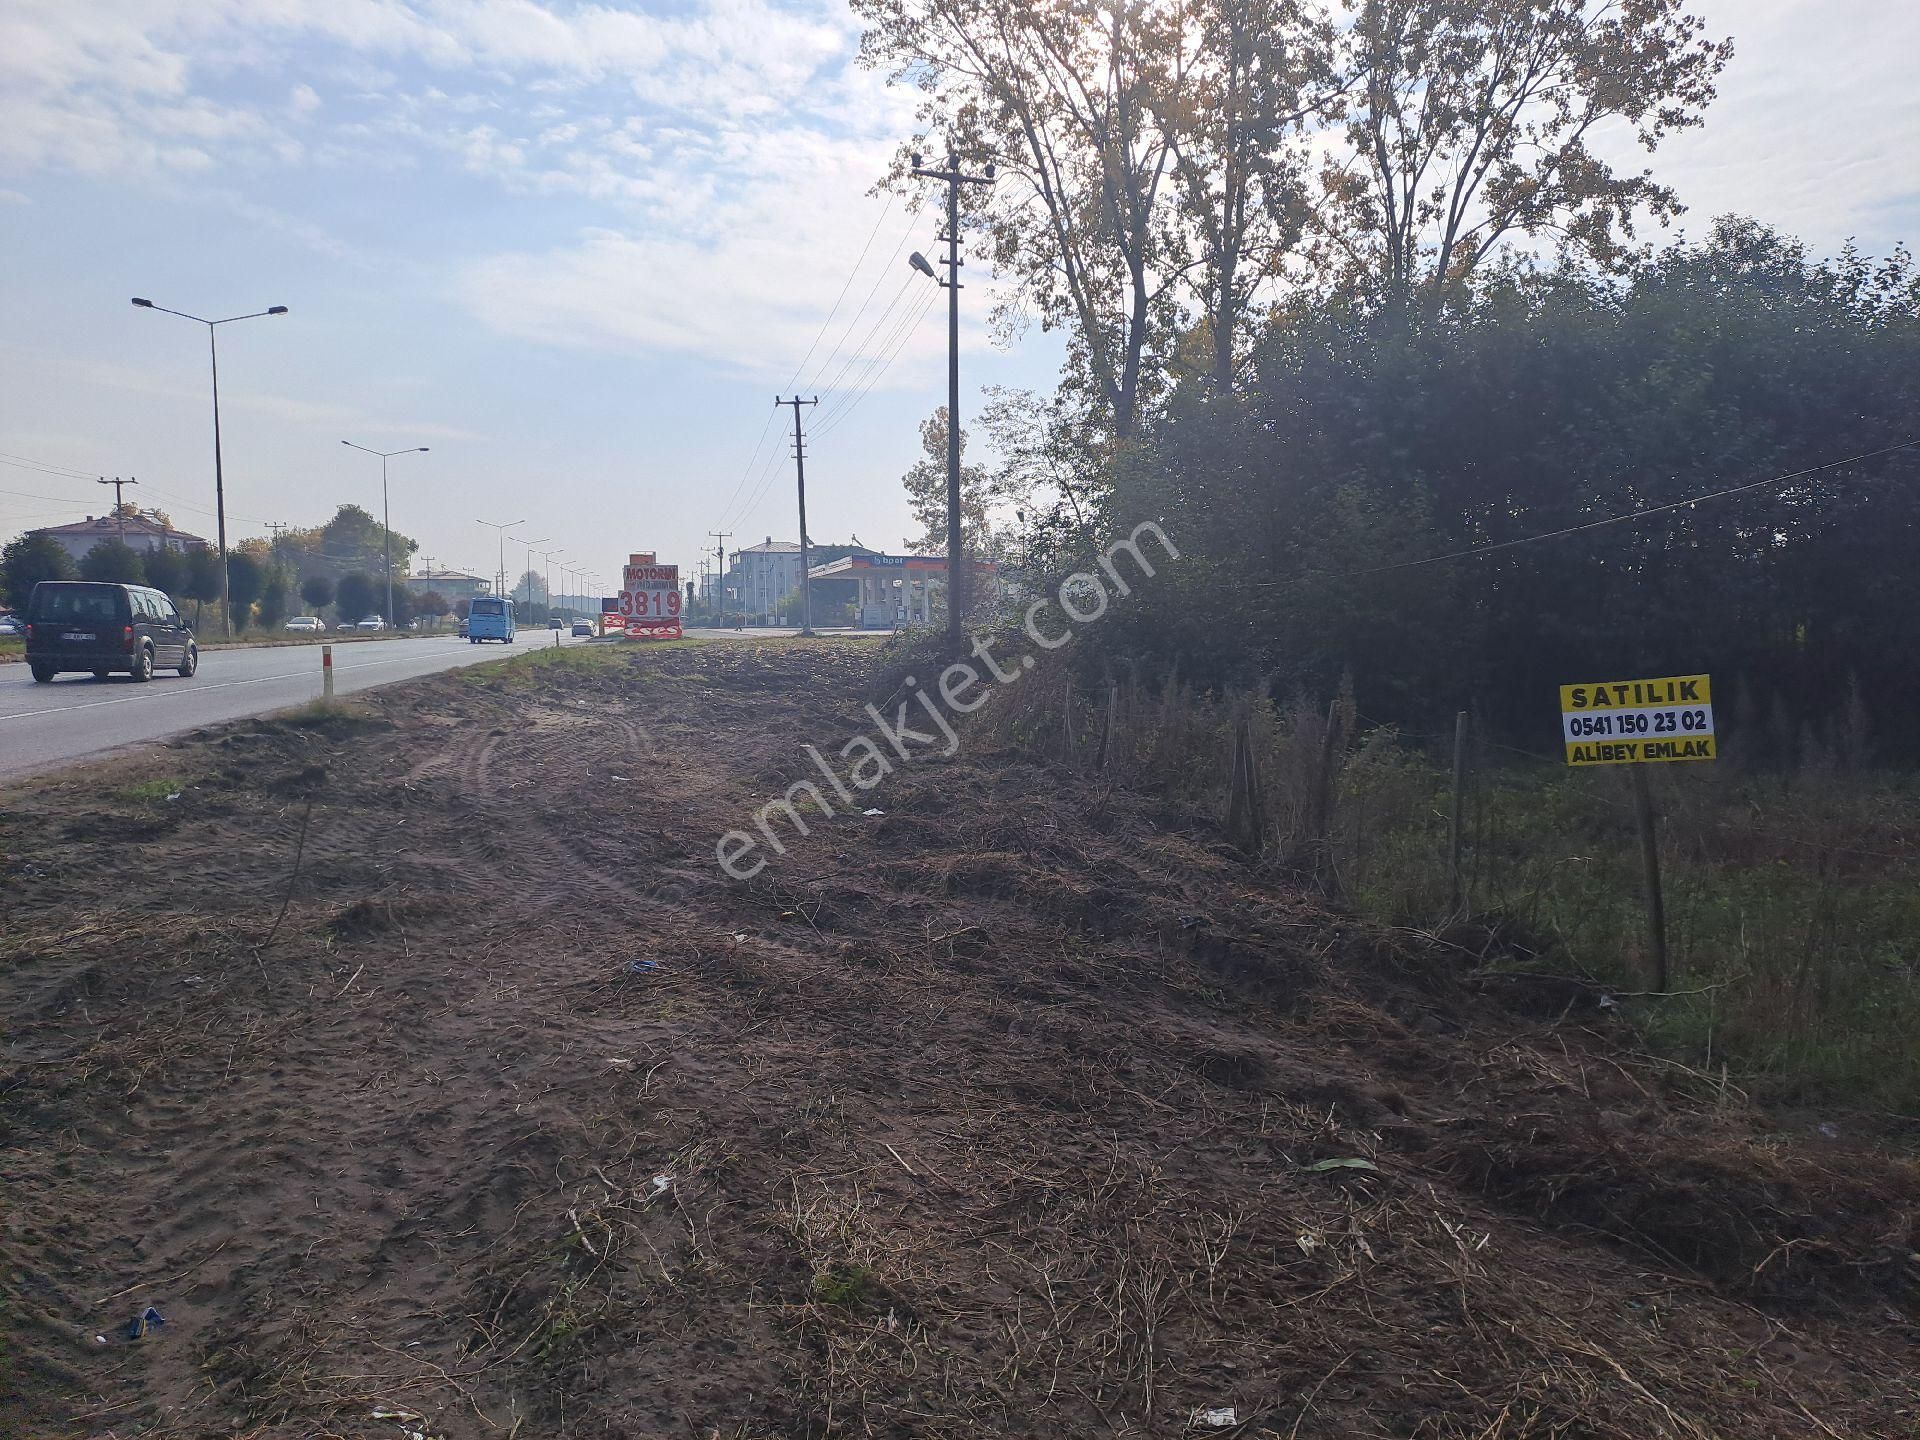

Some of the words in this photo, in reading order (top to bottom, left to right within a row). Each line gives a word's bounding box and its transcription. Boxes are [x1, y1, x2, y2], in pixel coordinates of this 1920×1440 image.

[619, 591, 681, 616] 3819
[1571, 680, 1699, 708] SATILIK
[1570, 716, 1612, 736] 0541
[1616, 713, 1648, 734] 150
[1653, 711, 1676, 732] 23
[1681, 710, 1707, 730] 02
[1572, 740, 1638, 762] ALİBEY
[1643, 740, 1711, 759] EMLAK
